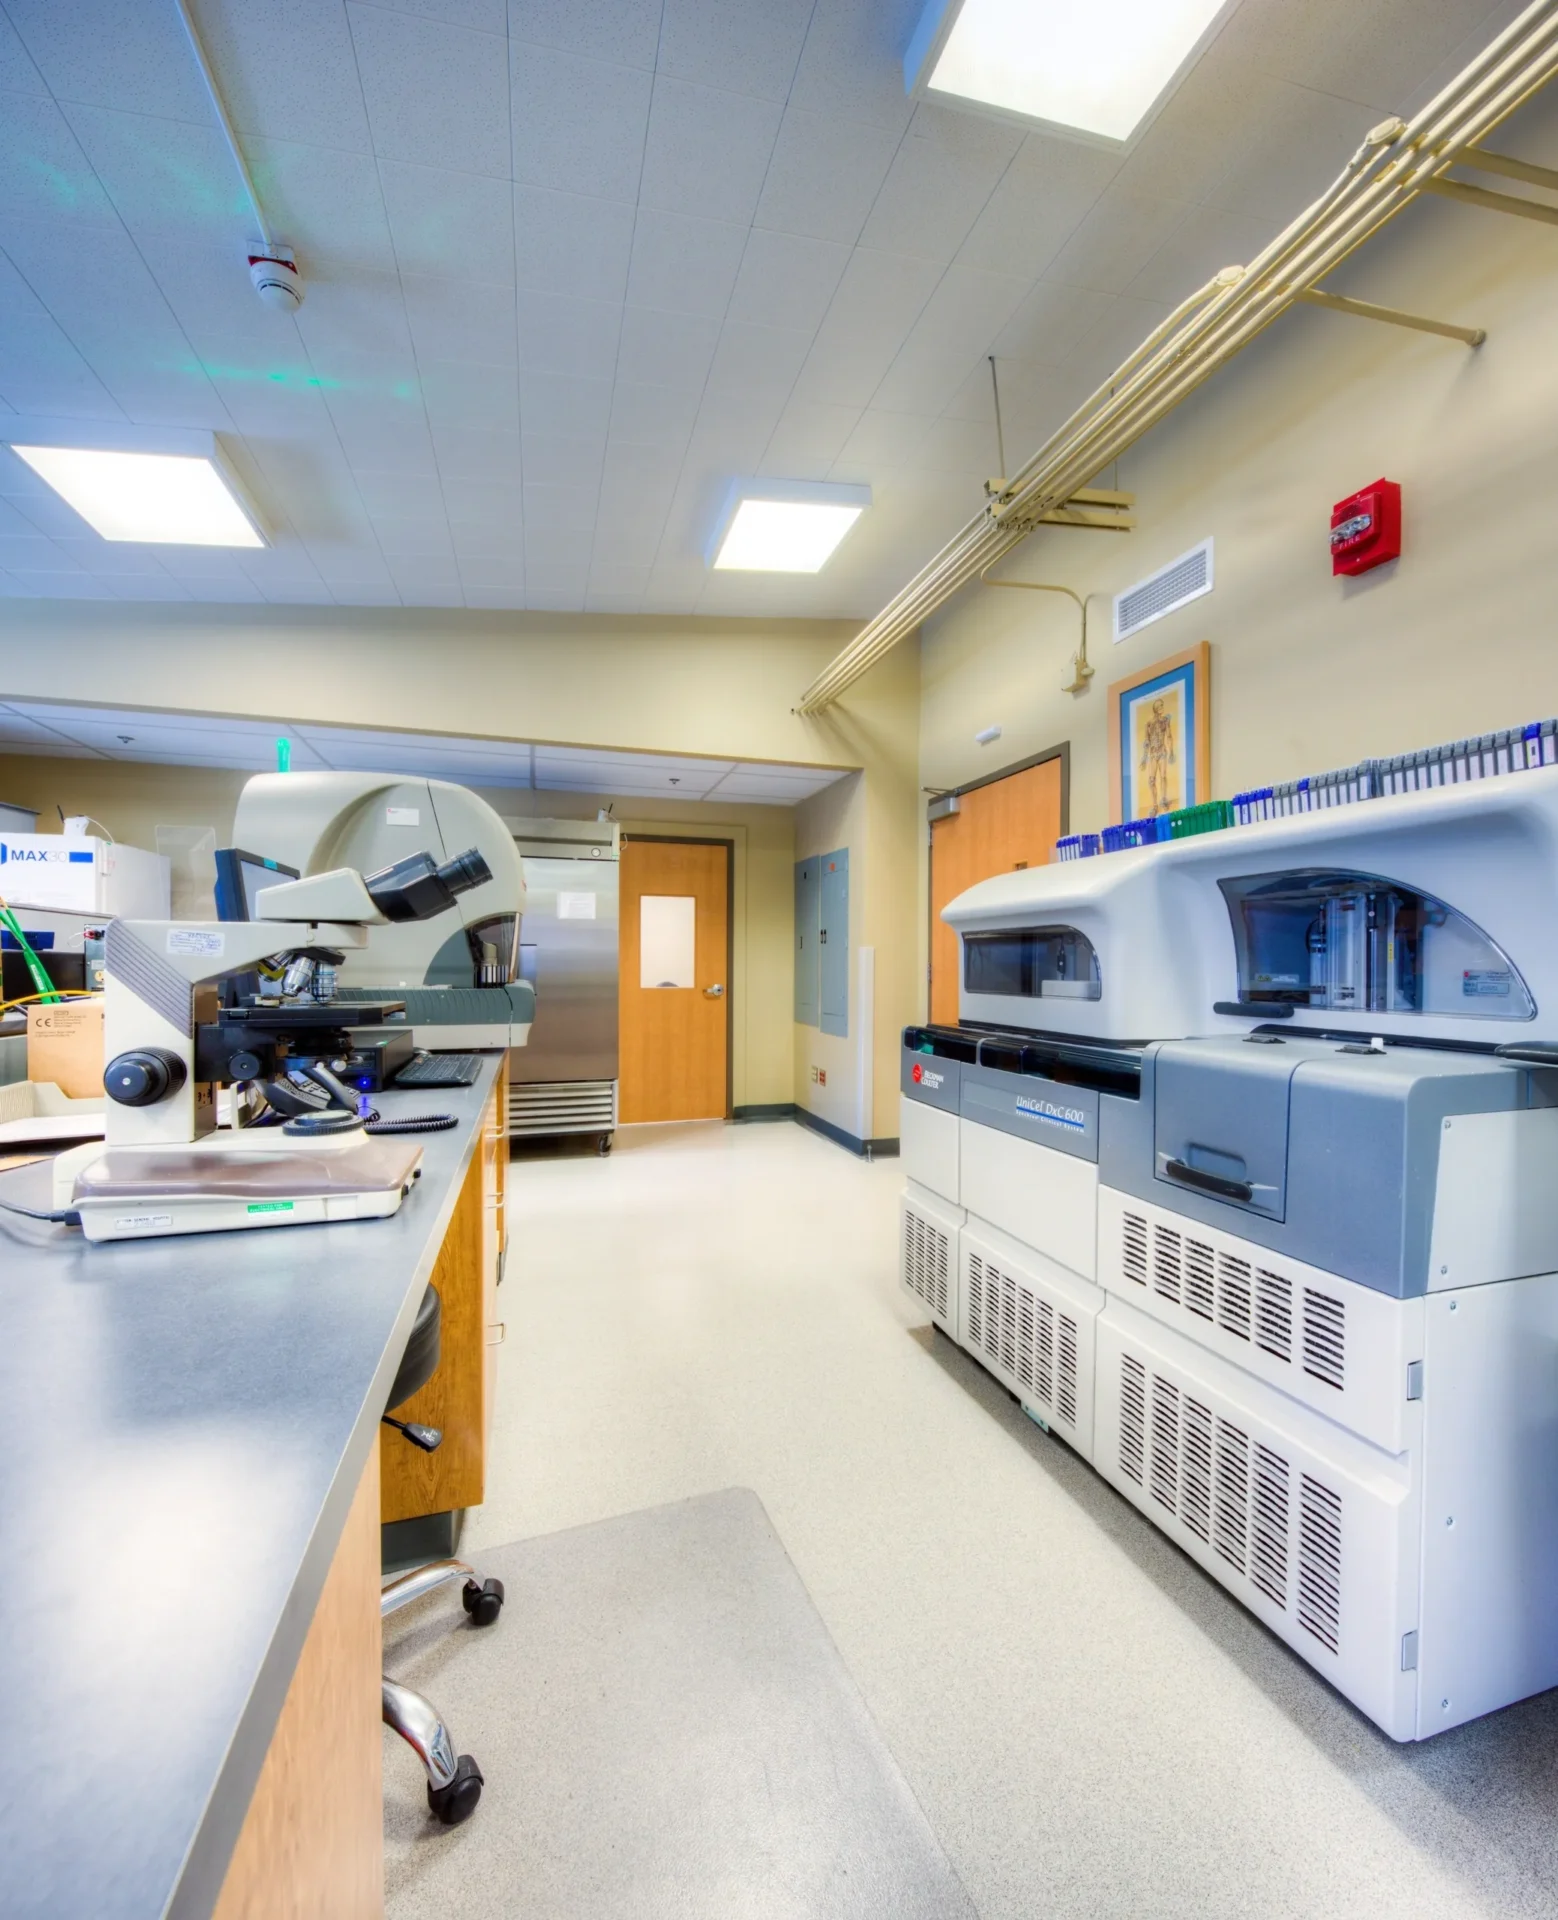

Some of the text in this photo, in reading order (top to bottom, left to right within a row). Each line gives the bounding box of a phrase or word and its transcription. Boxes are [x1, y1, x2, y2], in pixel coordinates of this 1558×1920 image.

[1339, 535, 1360, 549] FIRE
[921, 1077, 939, 1089] COULTER
[924, 1070, 944, 1083] BECKMAN
[1046, 1103, 1064, 1118] DxC
[1065, 1108, 1084, 1123] 600
[1064, 1123, 1085, 1133] System
